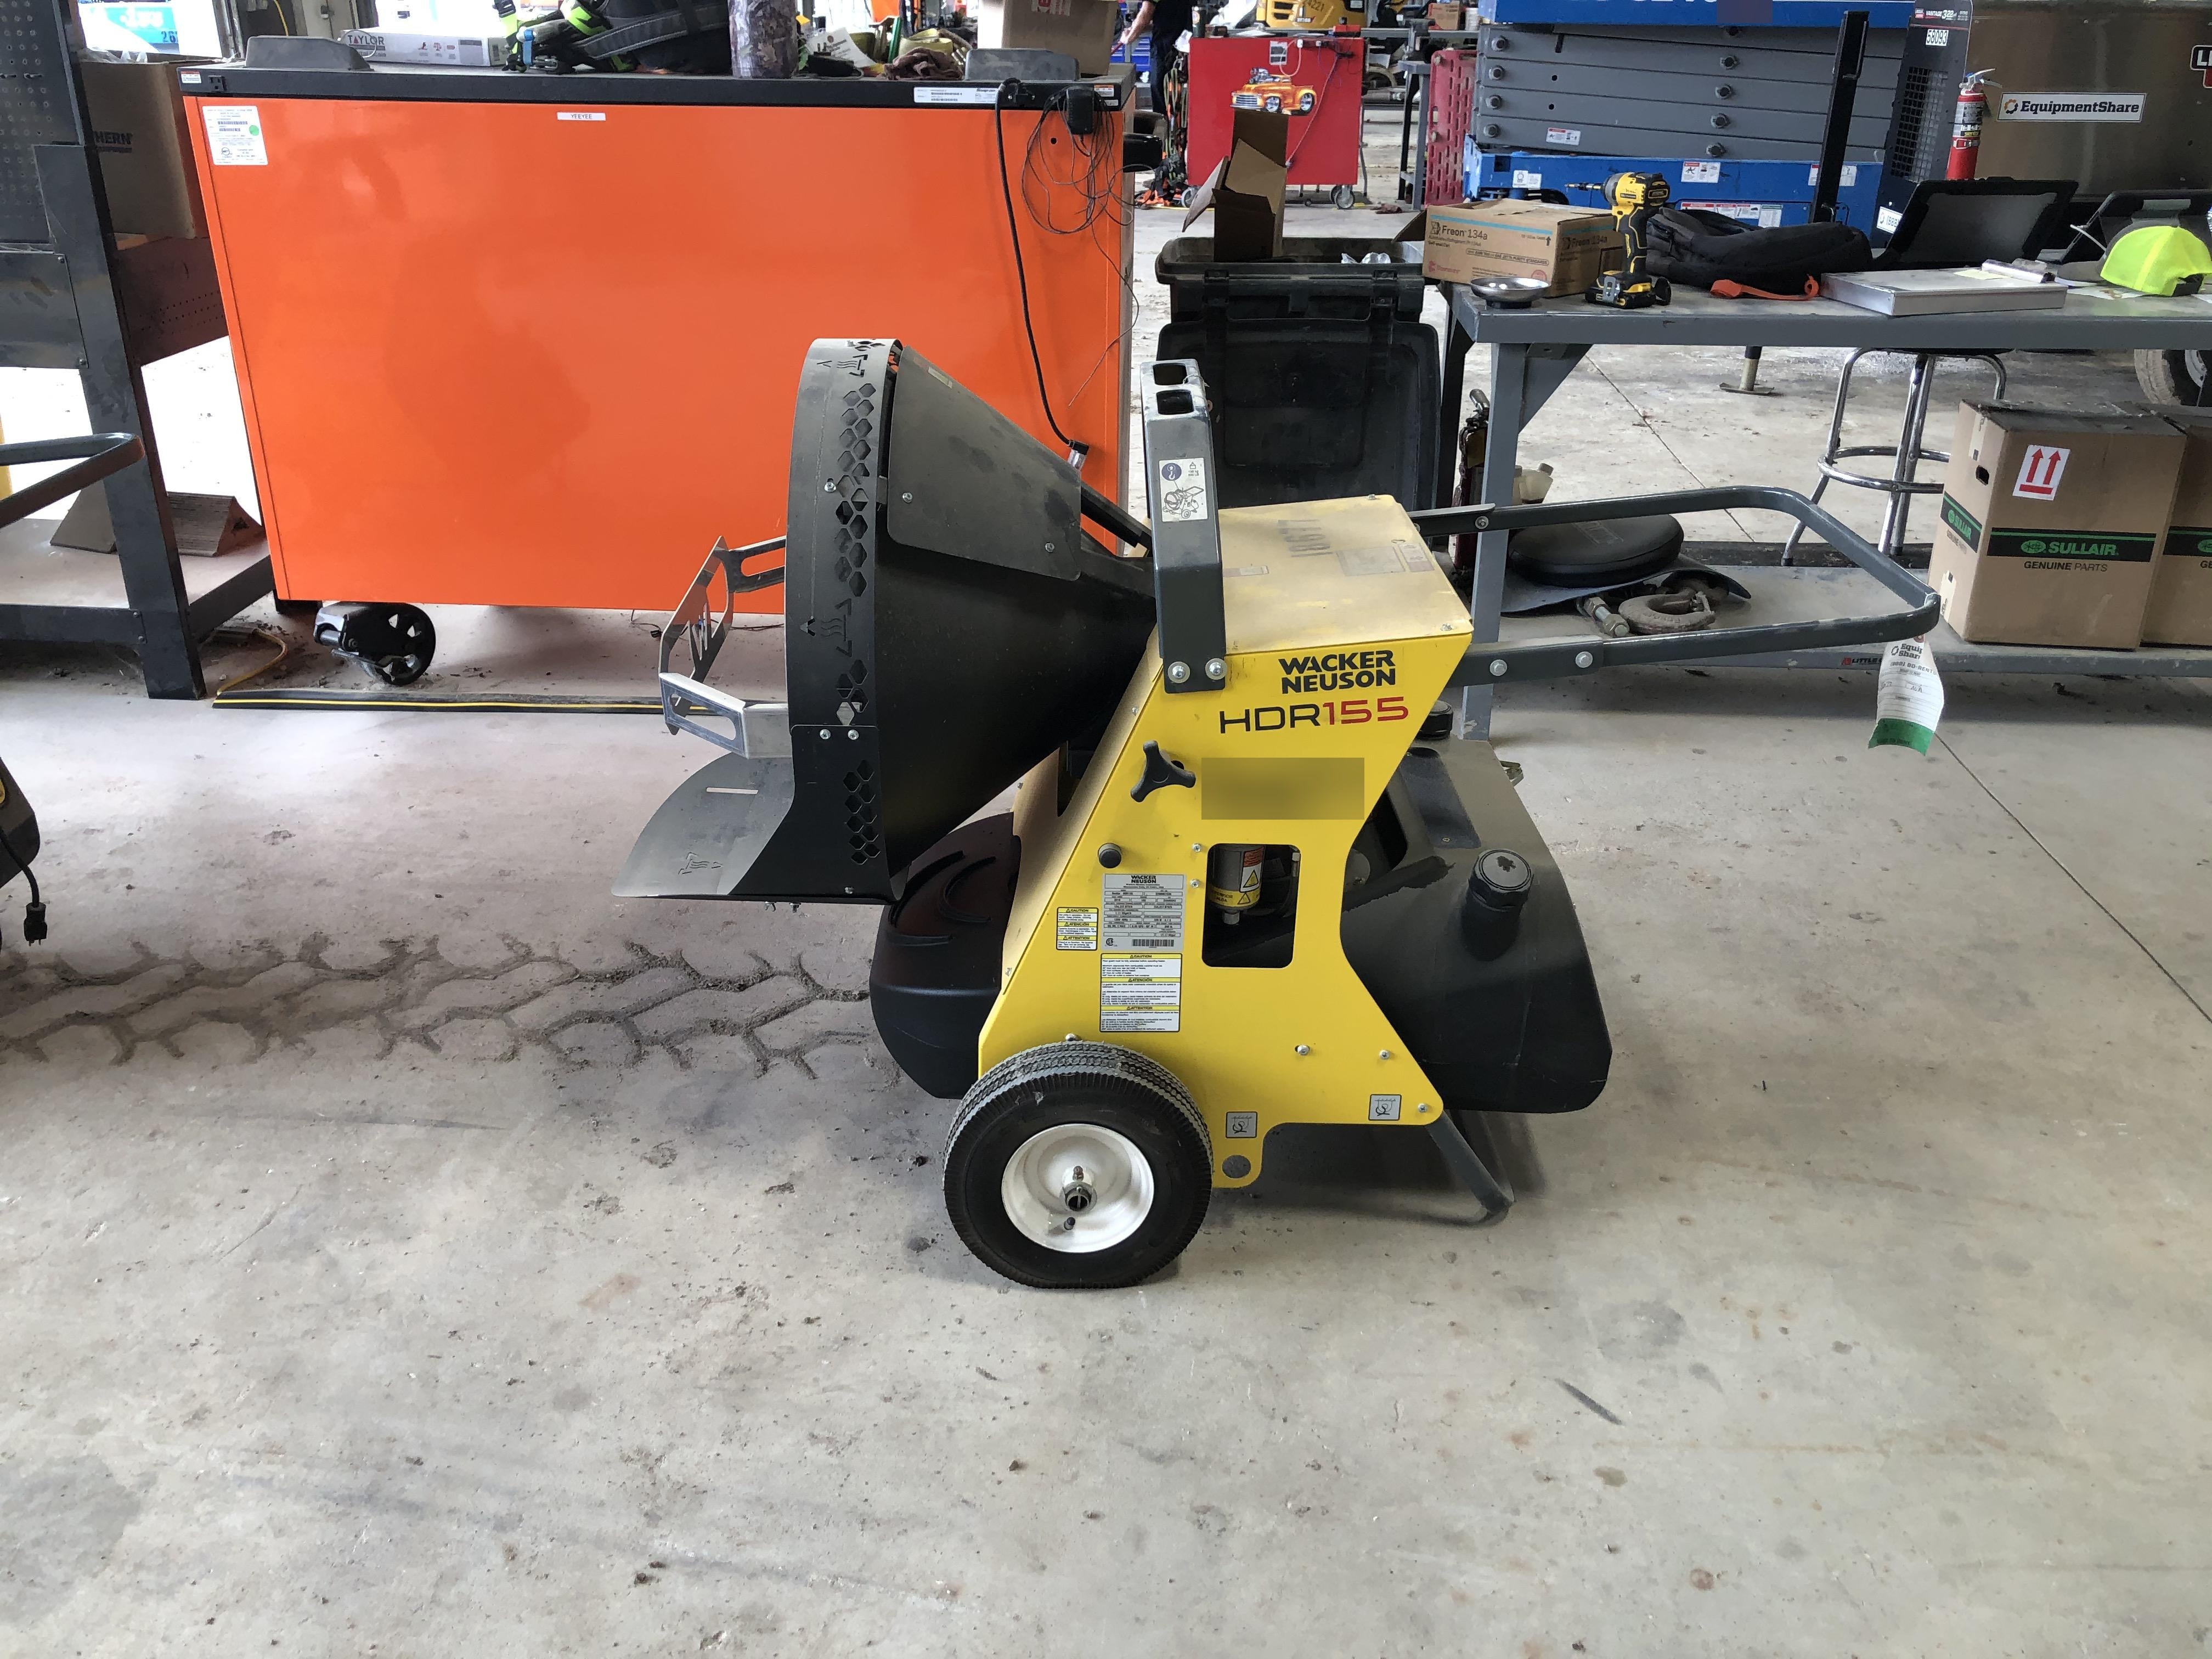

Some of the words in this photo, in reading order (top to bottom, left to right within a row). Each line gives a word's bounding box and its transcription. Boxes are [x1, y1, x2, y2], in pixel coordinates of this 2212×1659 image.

[347, 35, 384, 46] TAYLOR
[1926, 30, 1948, 44] 58093
[2020, 100, 2140, 115] EquipmentShare
[1468, 229, 1488, 240] 134a
[2049, 541, 2117, 556] SULLAIR
[2024, 561, 2072, 571] GENUINE
[2074, 562, 2108, 572] PARTS
[1278, 650, 1396, 675] WACKER
[1282, 668, 1396, 694] NEUSON
[1220, 697, 1409, 734] HDR155
